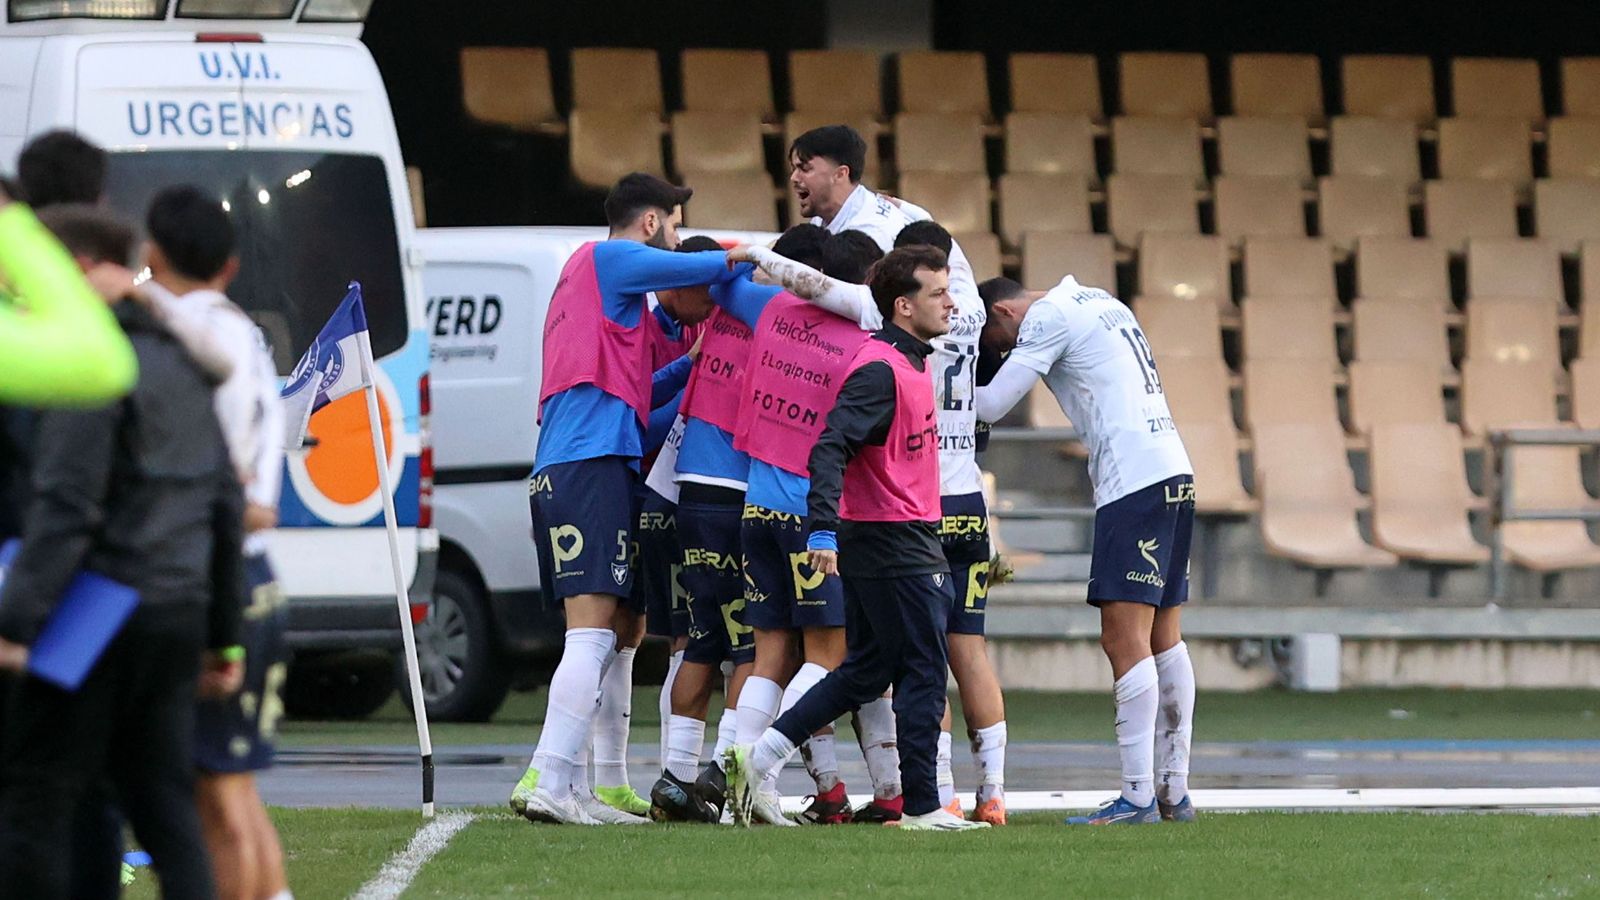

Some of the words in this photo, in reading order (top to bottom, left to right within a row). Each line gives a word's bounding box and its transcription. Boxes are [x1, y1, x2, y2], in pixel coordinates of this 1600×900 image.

[199, 51, 281, 79] U.V.I.
[127, 101, 353, 138] URGENCIAS
[768, 352, 833, 389] Logipack
[1120, 328, 1163, 395] 19
[616, 529, 628, 562] 5
